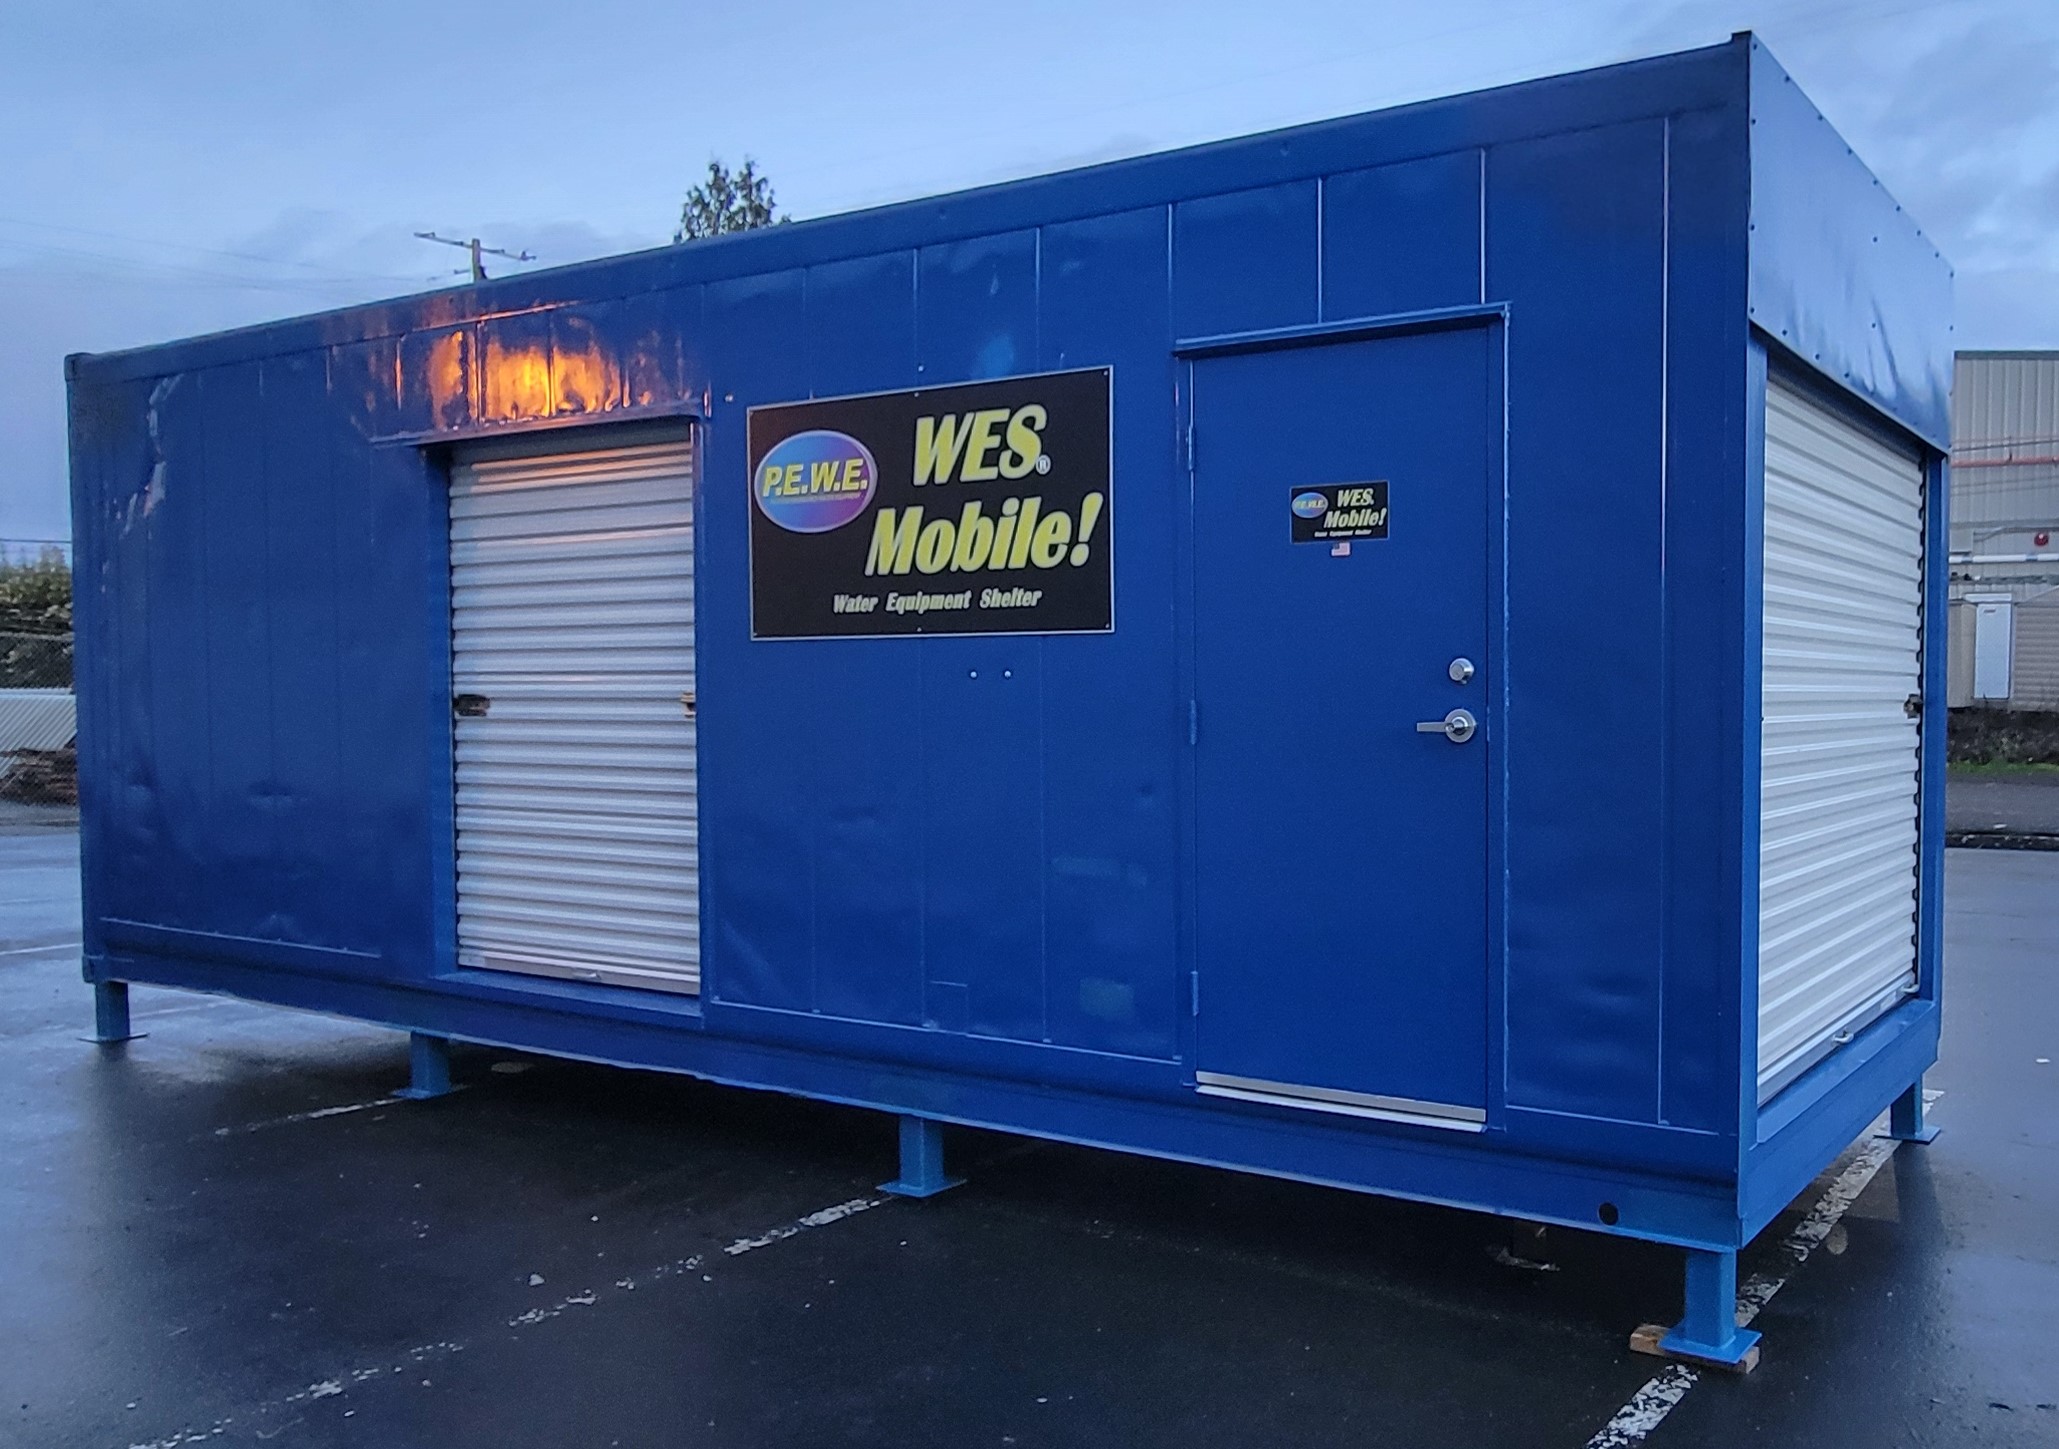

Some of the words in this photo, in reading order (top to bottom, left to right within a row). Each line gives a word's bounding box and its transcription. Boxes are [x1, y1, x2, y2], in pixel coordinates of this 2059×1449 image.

[762, 458, 868, 497] P.E.W.E.
[865, 492, 1104, 576] Mobile!
[1324, 507, 1387, 528] Mobile!
[833, 594, 879, 613] Water
[885, 590, 972, 614] Equipment
[979, 587, 1043, 608] Shelter
